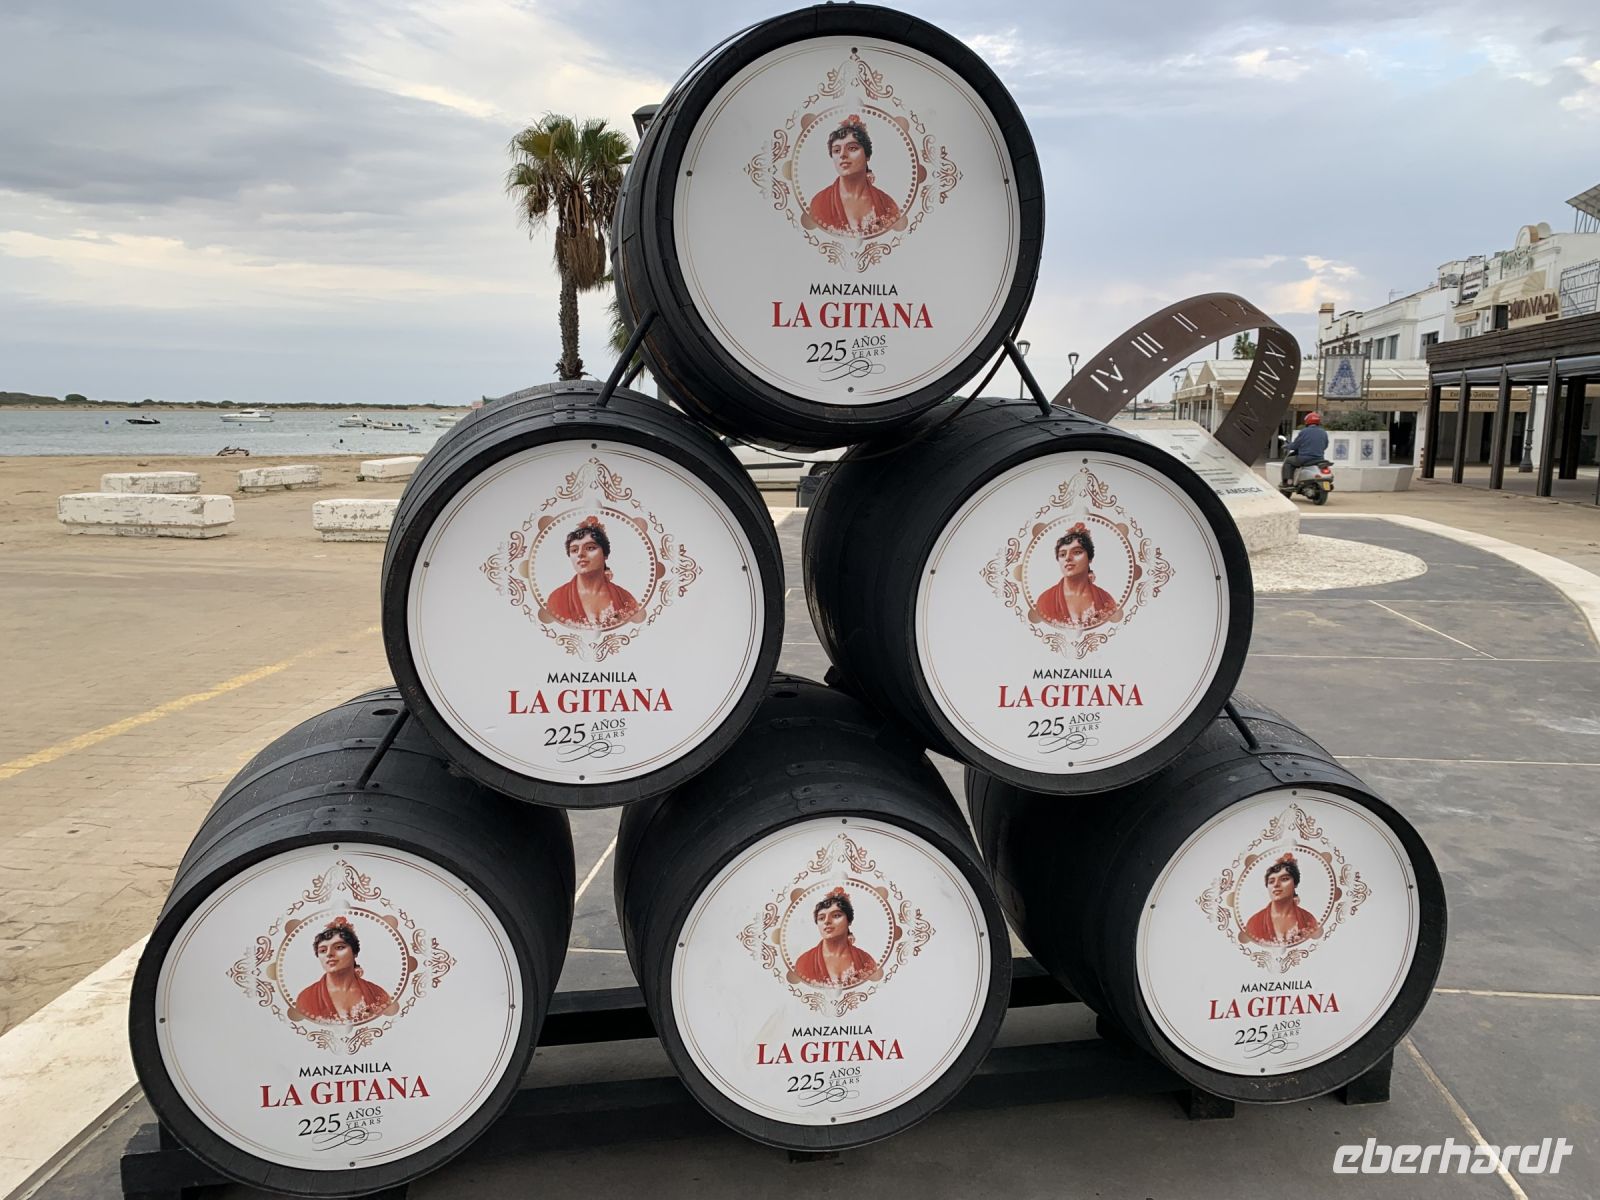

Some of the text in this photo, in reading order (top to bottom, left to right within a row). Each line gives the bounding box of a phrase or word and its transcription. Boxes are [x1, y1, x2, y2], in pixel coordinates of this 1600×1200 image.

[809, 283, 898, 296] MANZANILLA
[772, 301, 934, 329] LA GITANA
[806, 334, 886, 363] 225 AÑOS
[851, 348, 885, 359] YEARS
[1225, 486, 1264, 495] AMERICA
[547, 672, 637, 683] MANZANILLA
[1033, 668, 1113, 679] MANZANILLA
[508, 688, 673, 714] LA GITANA
[998, 684, 1143, 708] LA GITANA
[544, 718, 626, 746] 225 AÑOS
[1027, 712, 1100, 738] 225 AÑOS
[1068, 724, 1099, 734] YEARS
[590, 730, 625, 741] YEARS
[1240, 980, 1313, 993] MANZANILLA
[1208, 992, 1340, 1020] LA GITANA
[791, 1025, 873, 1037] MANZANILLA
[1234, 1019, 1301, 1046] 225 AÑOS
[1272, 1029, 1300, 1040] YEARS
[756, 1039, 905, 1065] LA GITANA
[299, 1062, 392, 1078] MANZANILLA
[787, 1066, 861, 1093] 225 AÑOS
[828, 1077, 860, 1088] YEARS
[260, 1075, 431, 1108] LA GITANA
[298, 1106, 382, 1137] 225 AÑOS
[345, 1117, 381, 1130] YEARS
